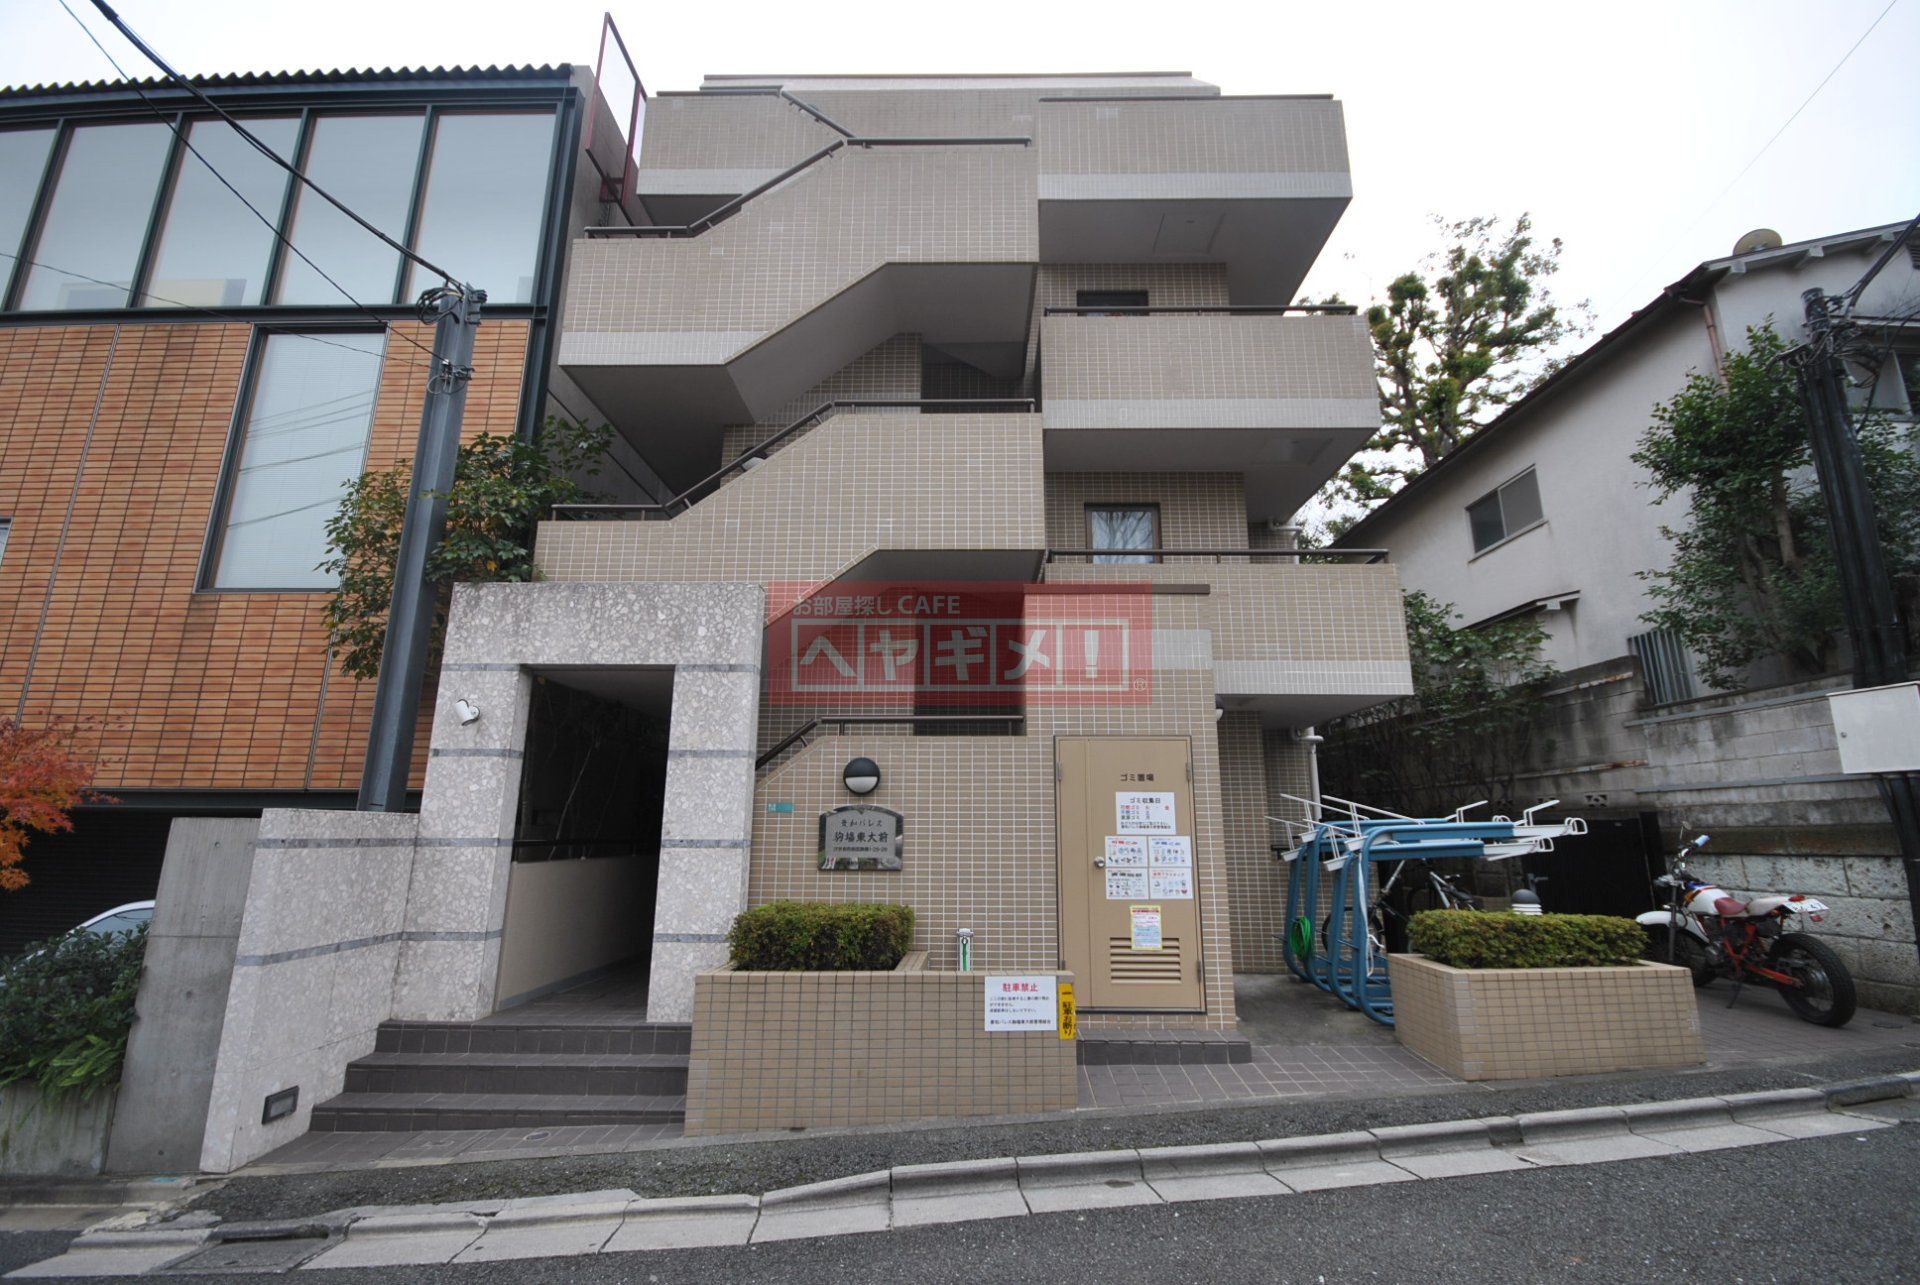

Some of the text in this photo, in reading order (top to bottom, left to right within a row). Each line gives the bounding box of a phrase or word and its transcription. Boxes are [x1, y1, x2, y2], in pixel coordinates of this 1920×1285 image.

[1120, 773, 1154, 782] ゴミ置場
[834, 831, 889, 843] 駒場東大前
[1002, 983, 1038, 993] 駐車禁止
[1062, 1001, 1073, 1036] 駐車お断り
